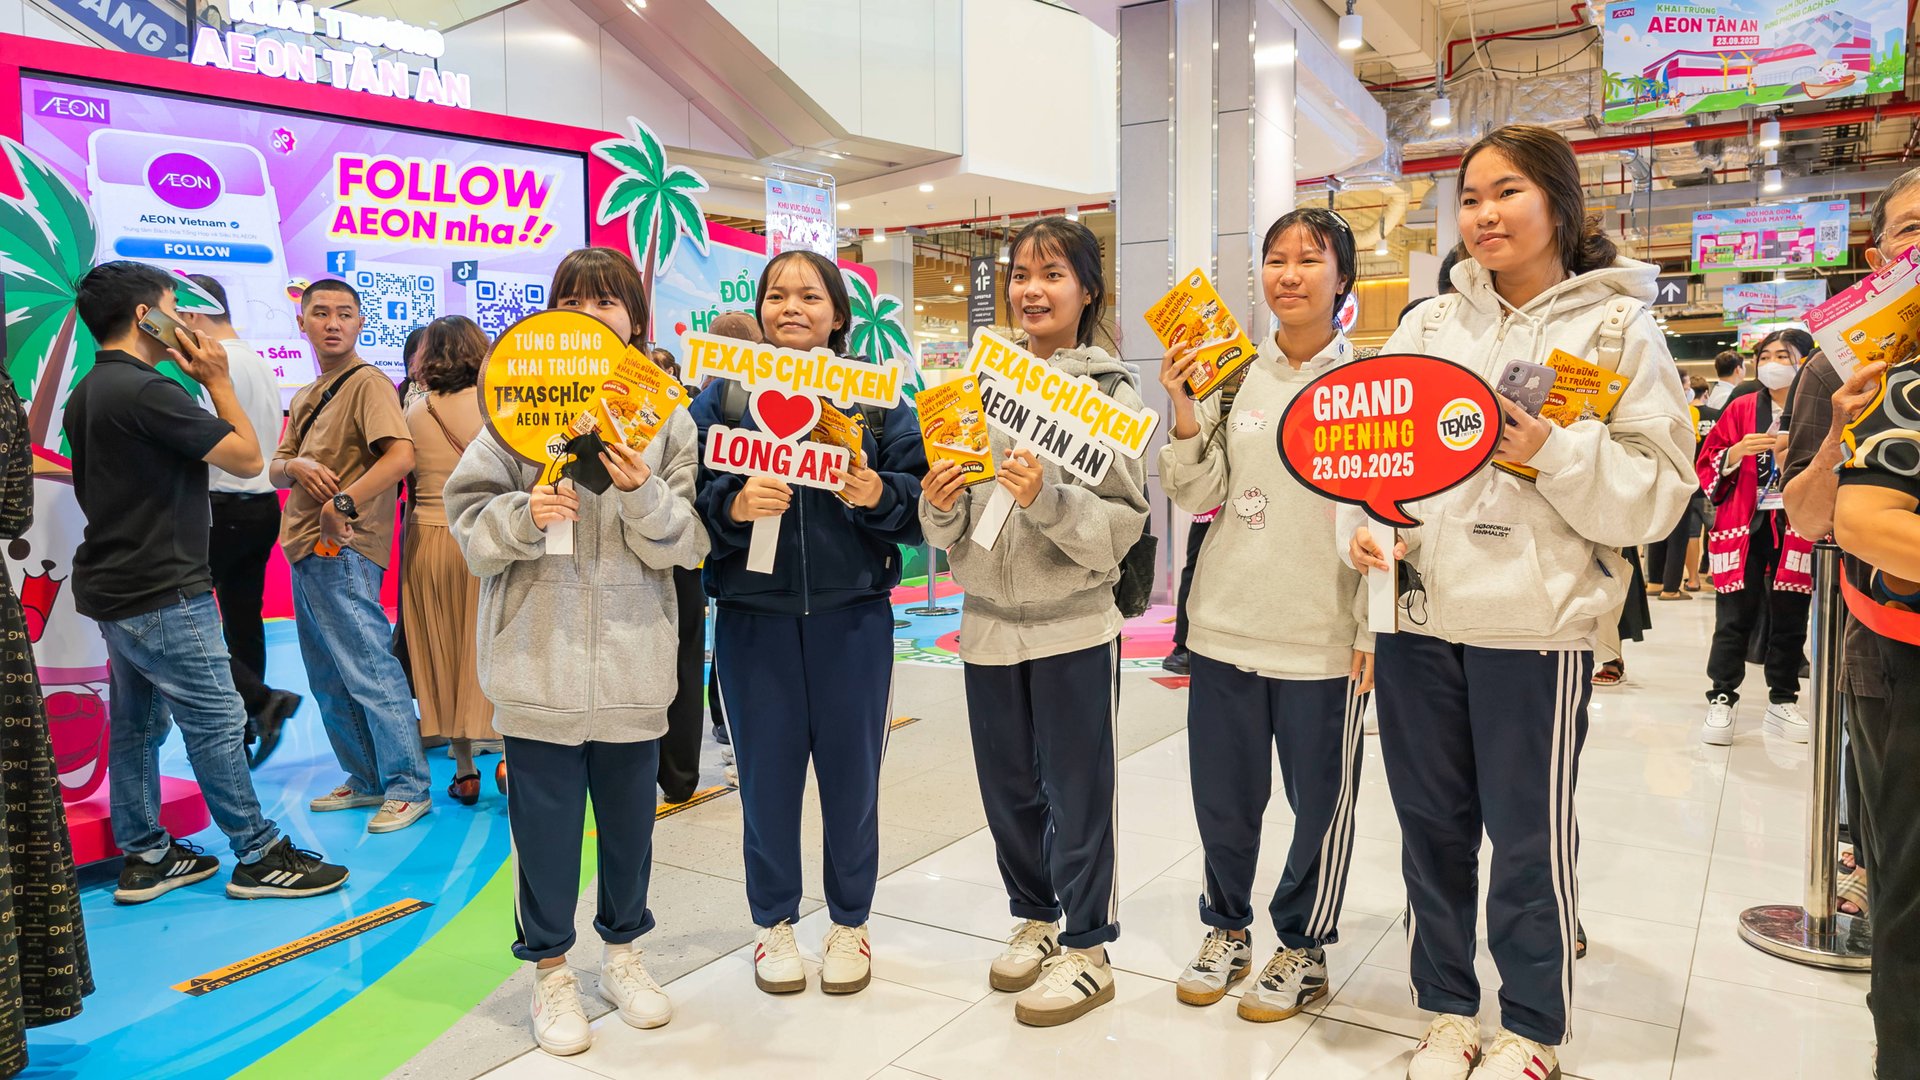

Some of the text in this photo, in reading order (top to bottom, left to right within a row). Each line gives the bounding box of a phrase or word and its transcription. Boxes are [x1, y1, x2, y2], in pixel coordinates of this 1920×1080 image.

[1657, 4, 1681, 13] KHAI
[1648, 16, 1702, 33] AEON
[1707, 16, 1736, 32] TÂN
[1740, 20, 1758, 32] AN
[1716, 36, 1758, 46] 23.09.2025
[191, 27, 471, 109] AEON TÂN AN
[340, 158, 556, 209] FOLLOW
[139, 214, 227, 228] AEON Vietnam
[332, 205, 437, 239] AEON
[164, 243, 230, 257] FOLLOW
[720, 269, 756, 303] ĐỔI
[976, 276, 990, 291] 1F
[691, 304, 721, 333] HÓ
[1157, 318, 1171, 333] KHAI
[1851, 332, 1865, 342] TEXAS
[268, 346, 302, 359] Sắm
[507, 358, 543, 376] KHAI
[617, 364, 634, 376] KHAI
[1312, 378, 1413, 422] GRAND
[516, 412, 549, 426] AEON
[1440, 412, 1482, 438] TEXAS
[980, 386, 1028, 434] AEON
[1030, 415, 1073, 459] TÂN
[1071, 443, 1106, 479] AN
[1314, 418, 1414, 453] OPENING
[1460, 428, 1483, 437] CHICKEN
[711, 432, 843, 485] LONG AN
[1312, 452, 1414, 480] 23.09.2025
